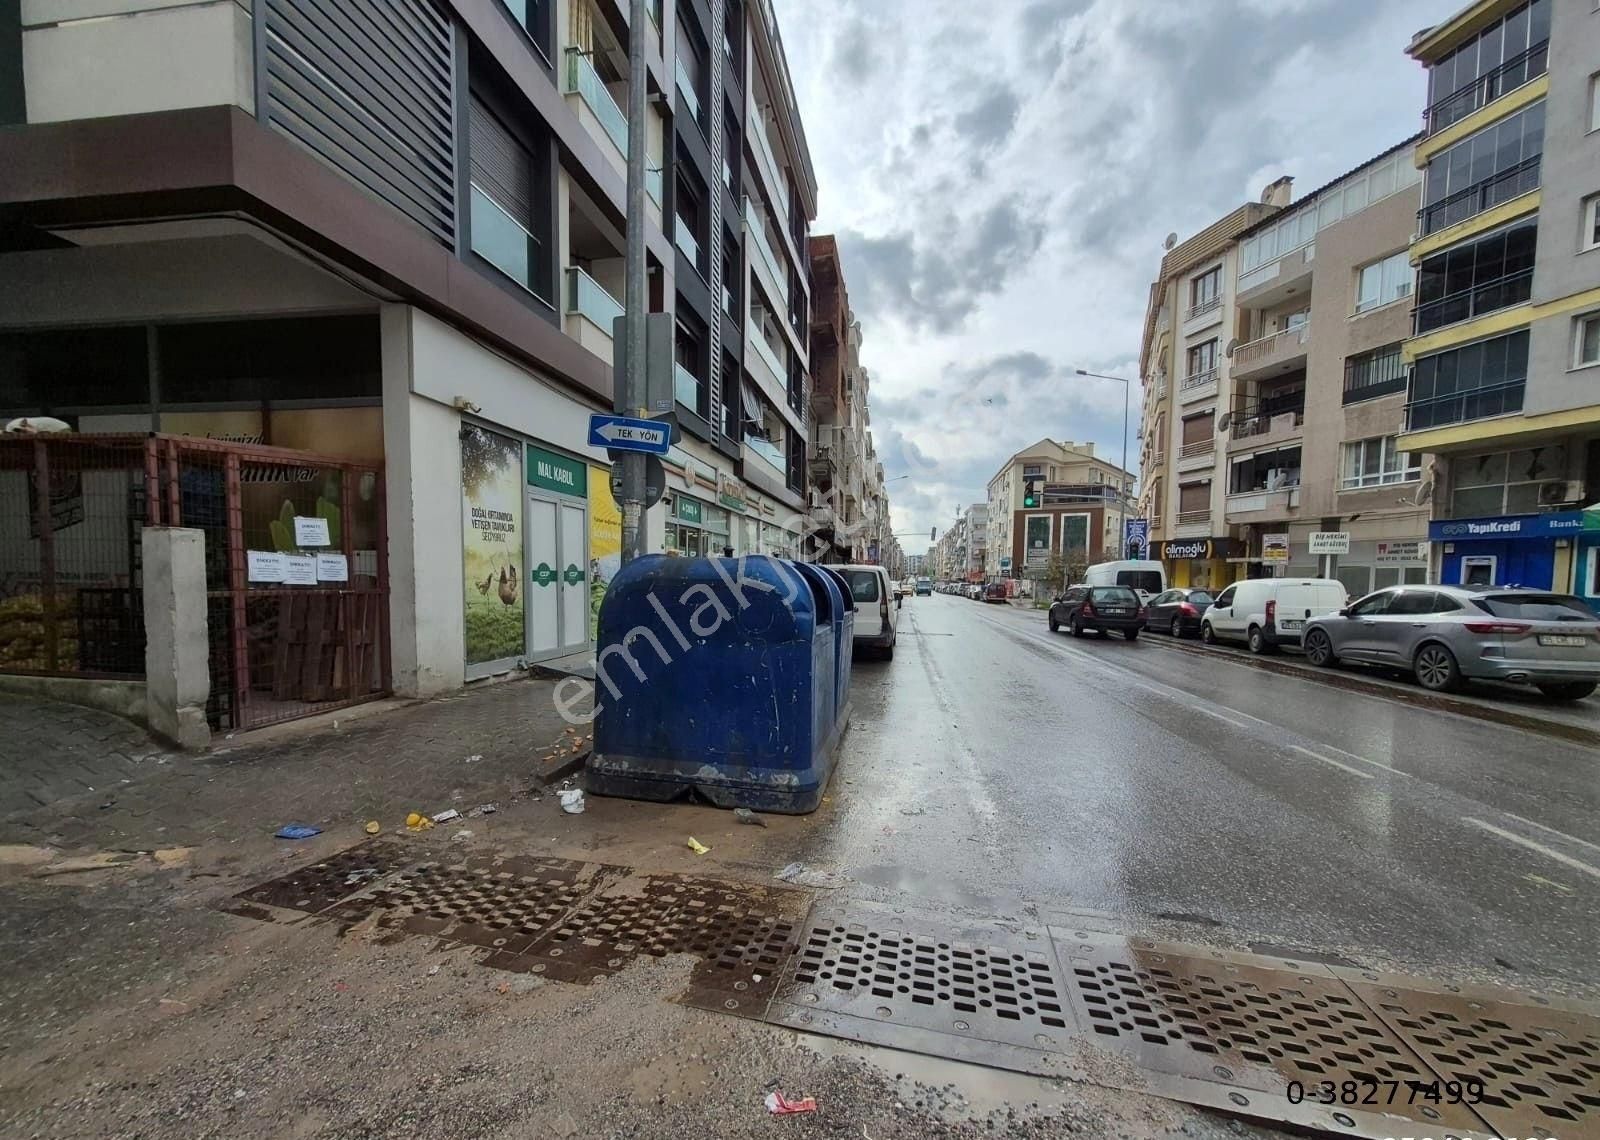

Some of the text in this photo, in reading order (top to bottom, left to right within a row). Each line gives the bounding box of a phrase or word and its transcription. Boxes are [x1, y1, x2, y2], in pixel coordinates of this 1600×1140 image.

[617, 428, 658, 441] TEK YÖN
[537, 460, 575, 486] MAL KABUL
[1467, 521, 1521, 534] YapıKredi
[1165, 541, 1206, 558] alimoğlu
